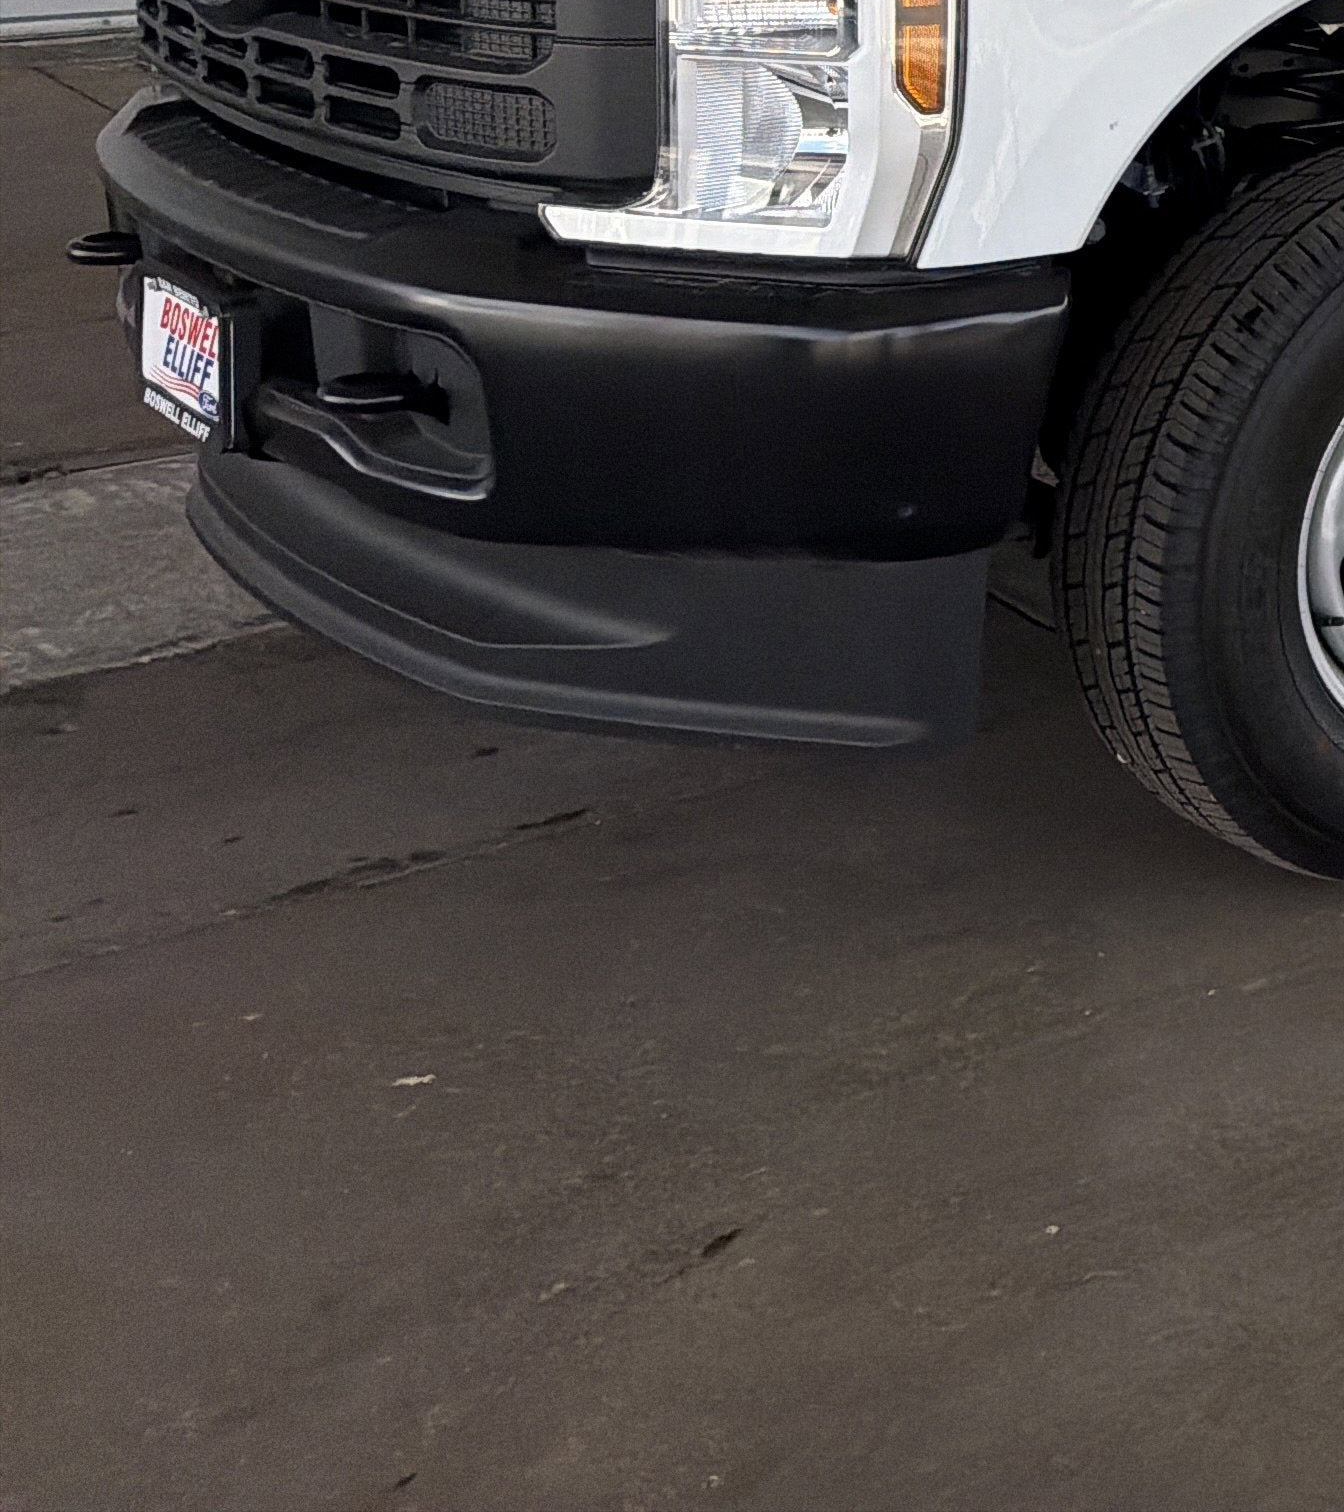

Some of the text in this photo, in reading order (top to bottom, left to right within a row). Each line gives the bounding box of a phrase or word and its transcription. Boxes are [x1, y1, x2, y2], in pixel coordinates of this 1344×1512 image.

[160, 296, 220, 360] BOSWEL
[162, 334, 215, 390] ELLIFF
[143, 387, 211, 443] BOSWELL ELLIFF
